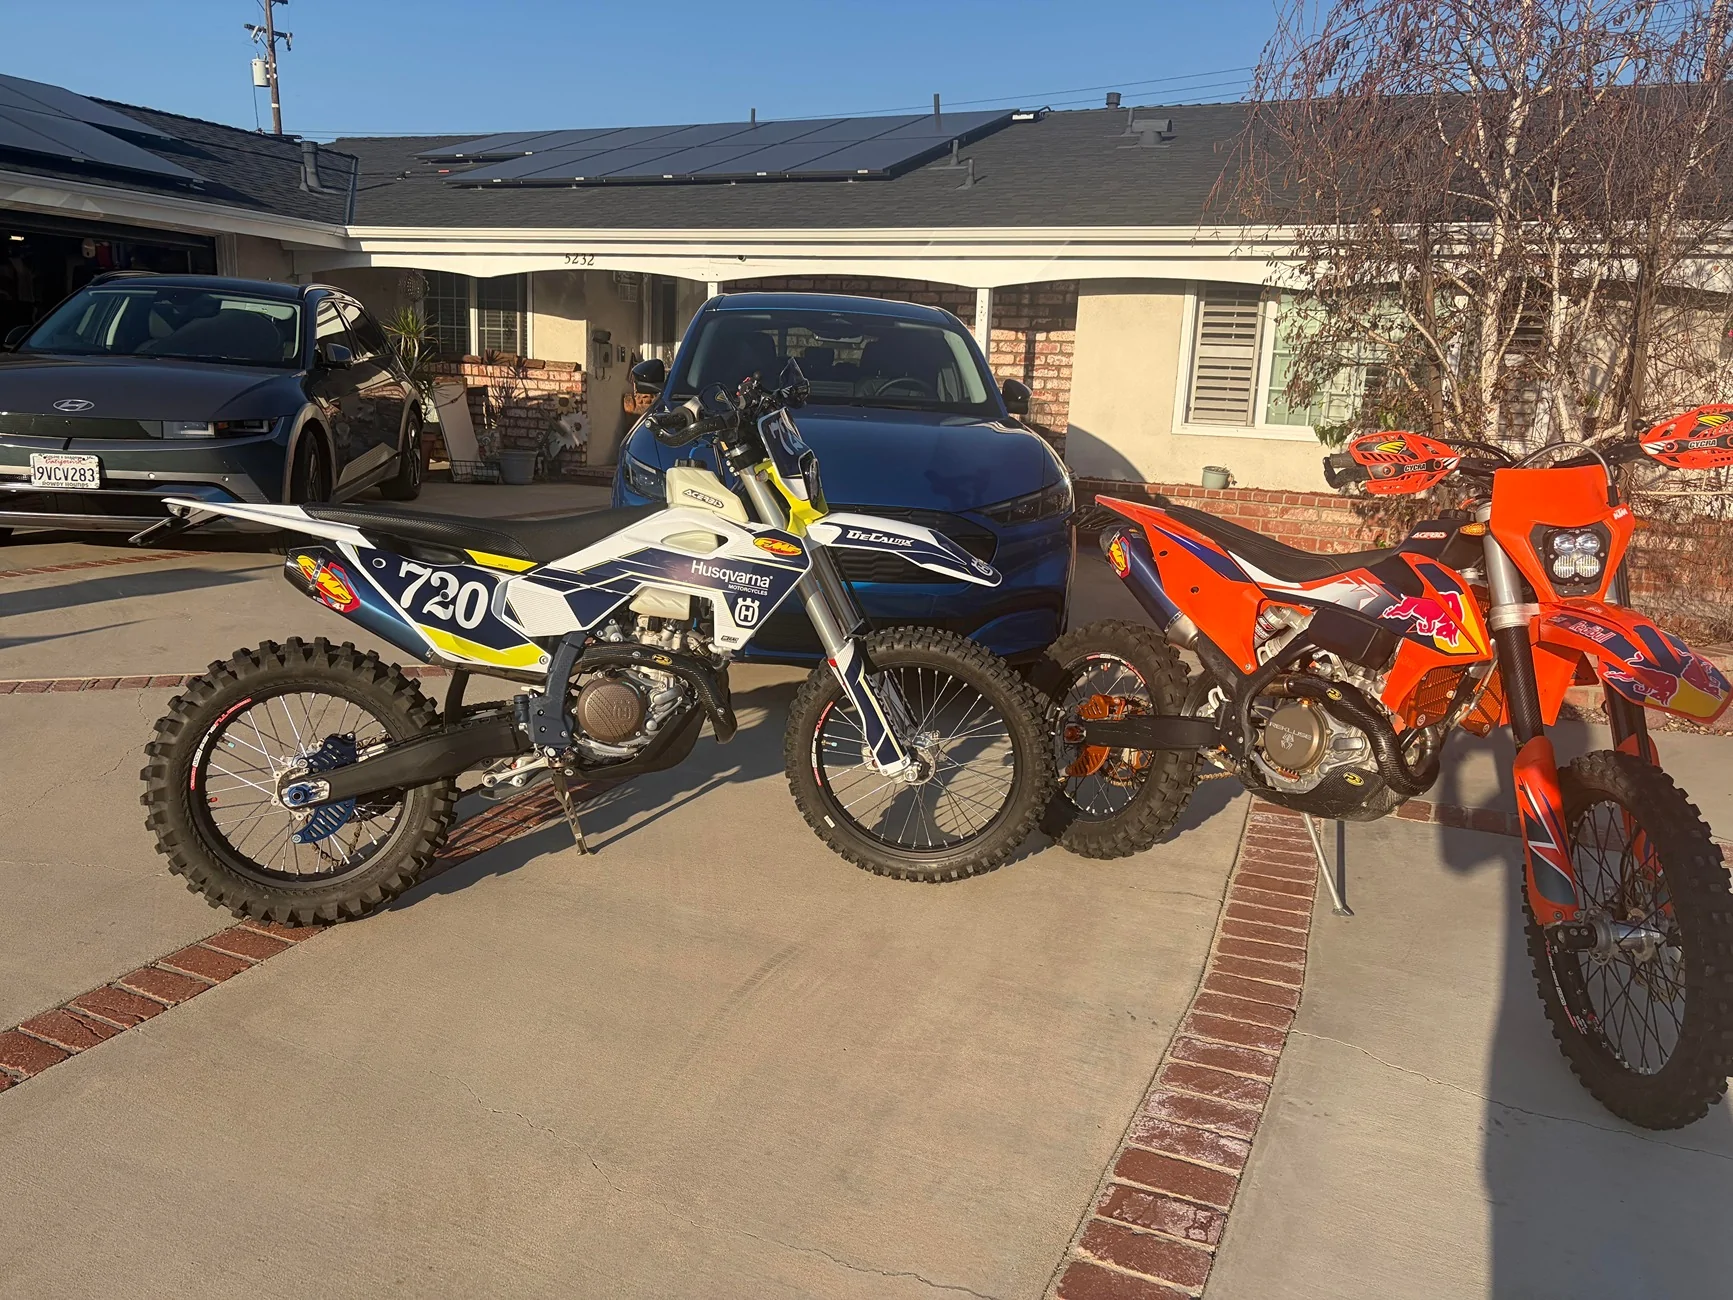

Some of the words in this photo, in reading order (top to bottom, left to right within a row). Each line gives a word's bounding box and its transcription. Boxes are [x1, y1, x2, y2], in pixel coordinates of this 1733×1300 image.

[564, 253, 595, 266] 5232
[1688, 438, 1717, 449] CYCRA
[1404, 462, 1426, 473] CYCRA
[36, 466, 95, 482] 9VCV283
[1613, 508, 1628, 520] KTM
[691, 560, 770, 588] Husqvarna
[399, 561, 488, 629] 720
[728, 584, 768, 596] MOTORCYCLES
